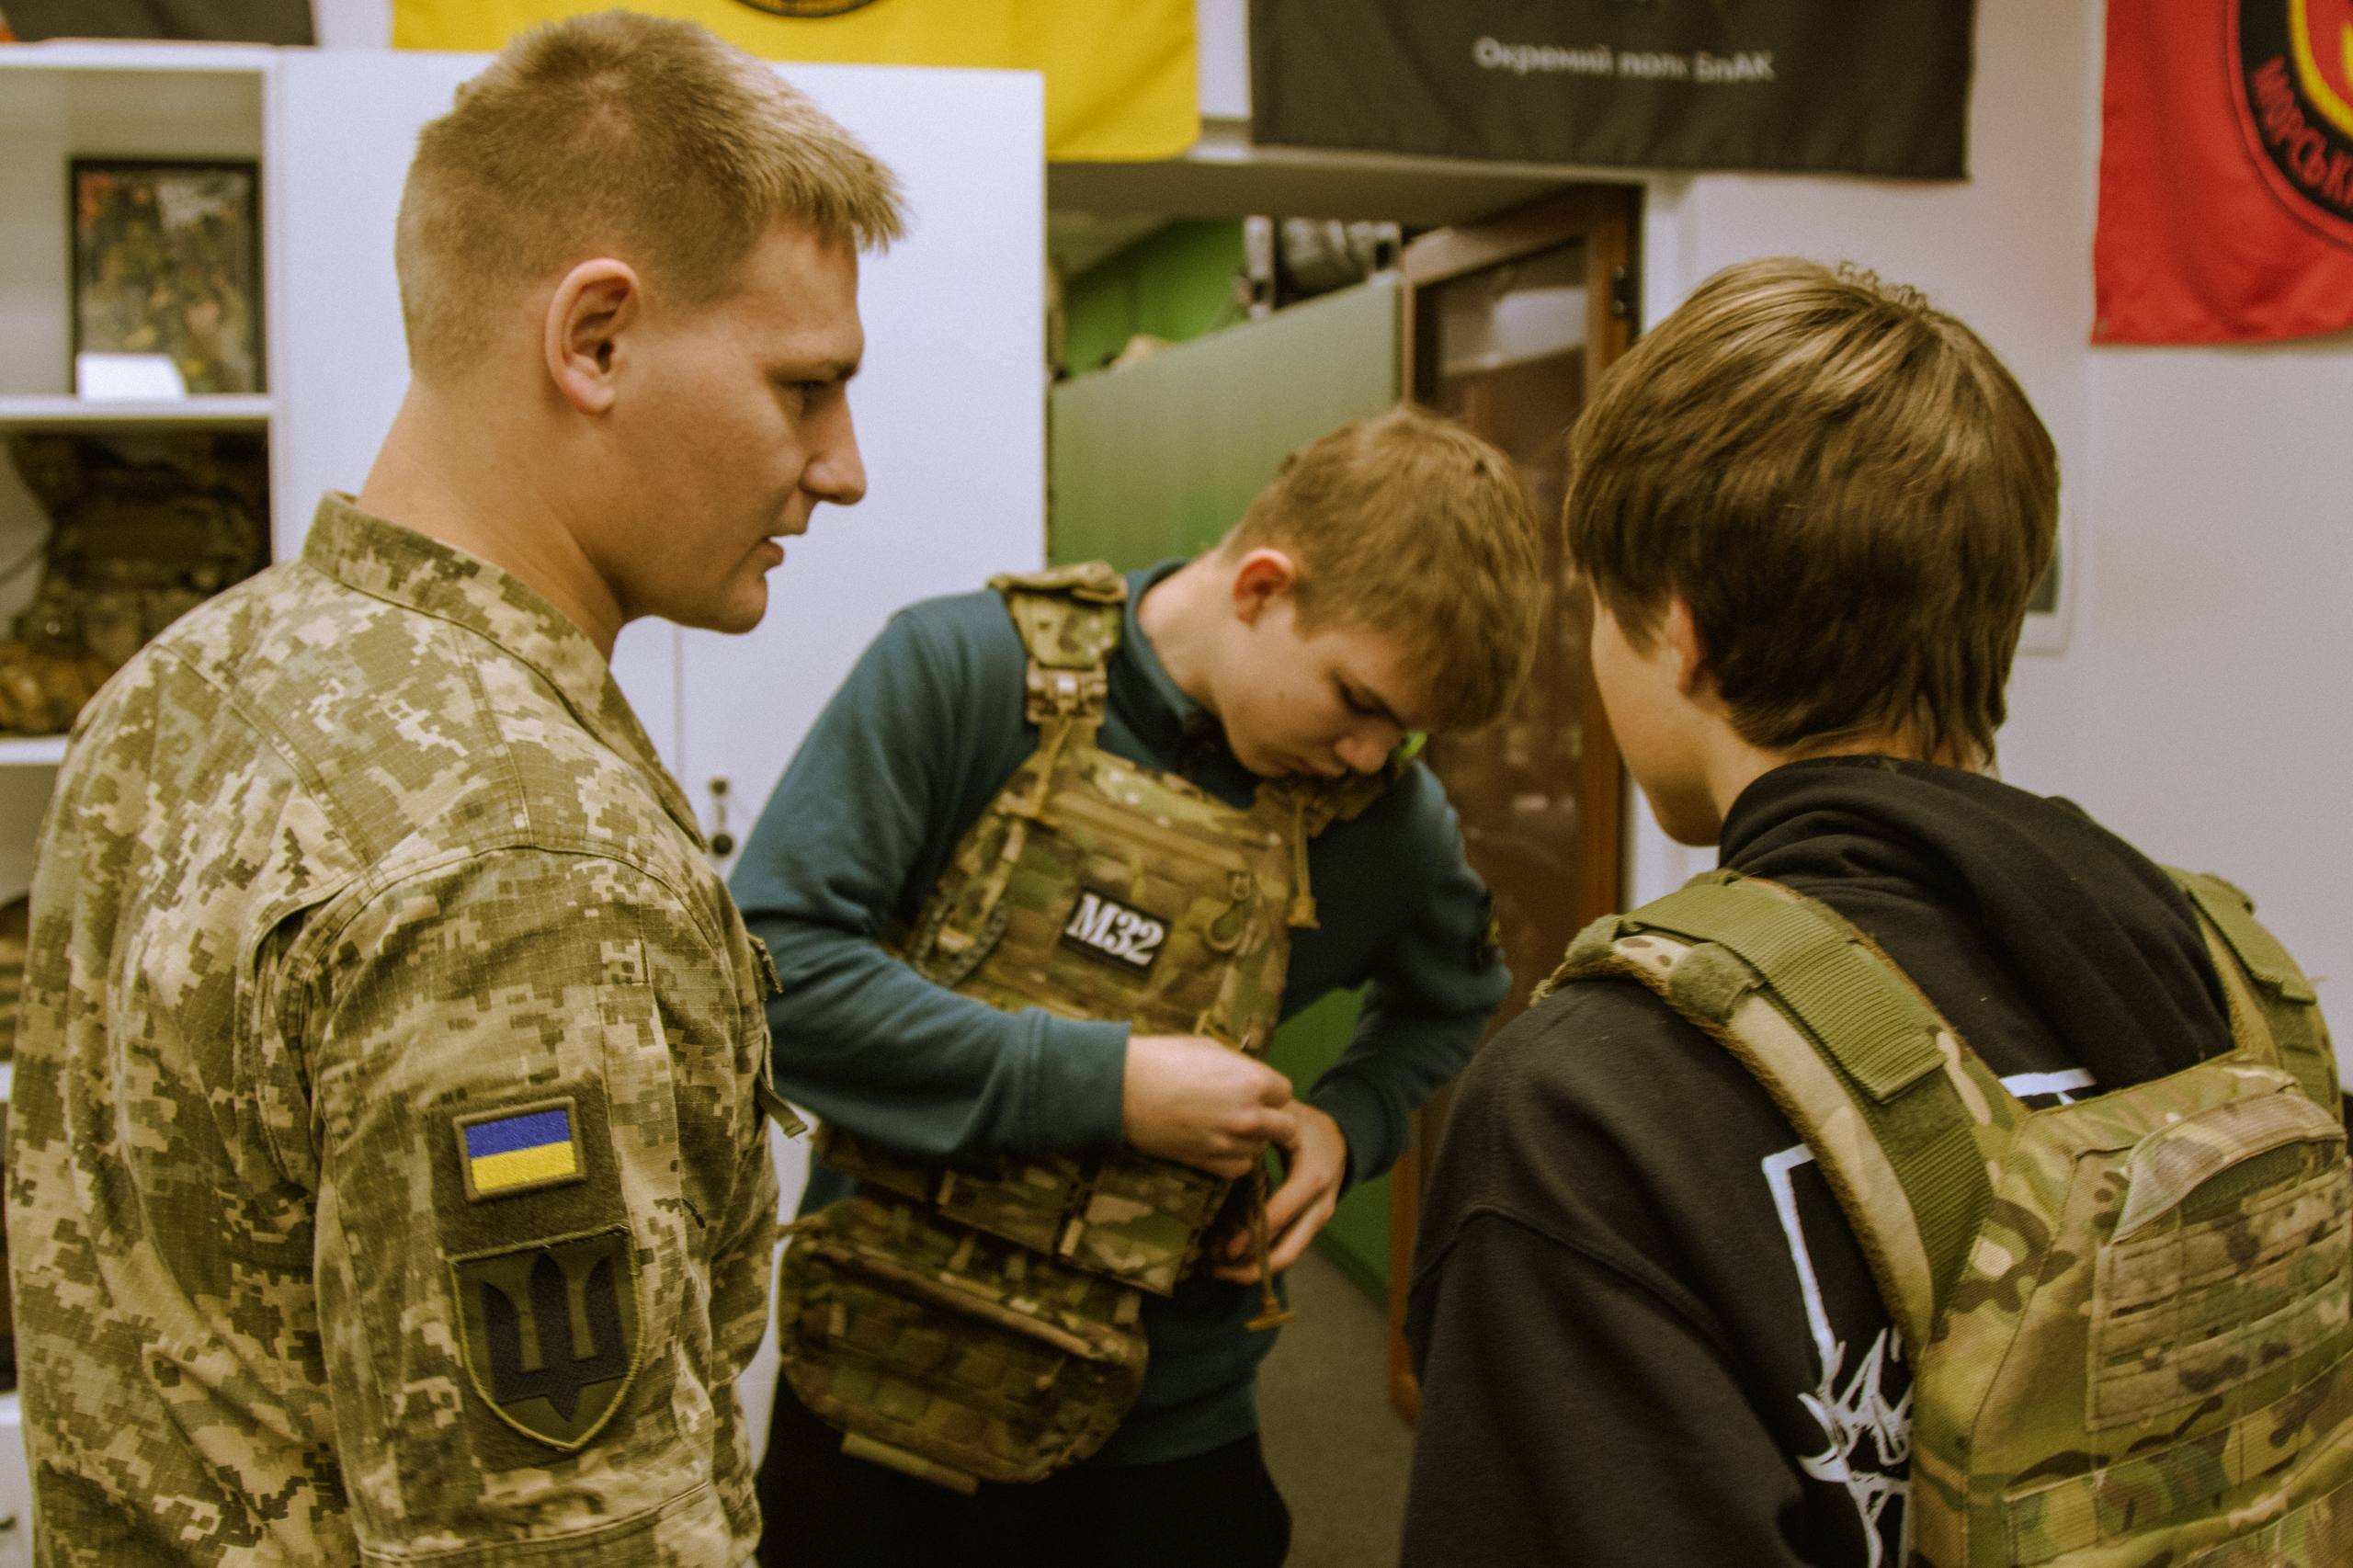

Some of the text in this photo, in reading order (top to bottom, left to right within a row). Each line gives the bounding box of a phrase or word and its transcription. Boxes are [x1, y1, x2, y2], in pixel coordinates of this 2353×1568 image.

[1617, 50, 1690, 80] полк
[2254, 53, 2353, 208] МОРСЬК
[1065, 892, 1164, 966] M32
